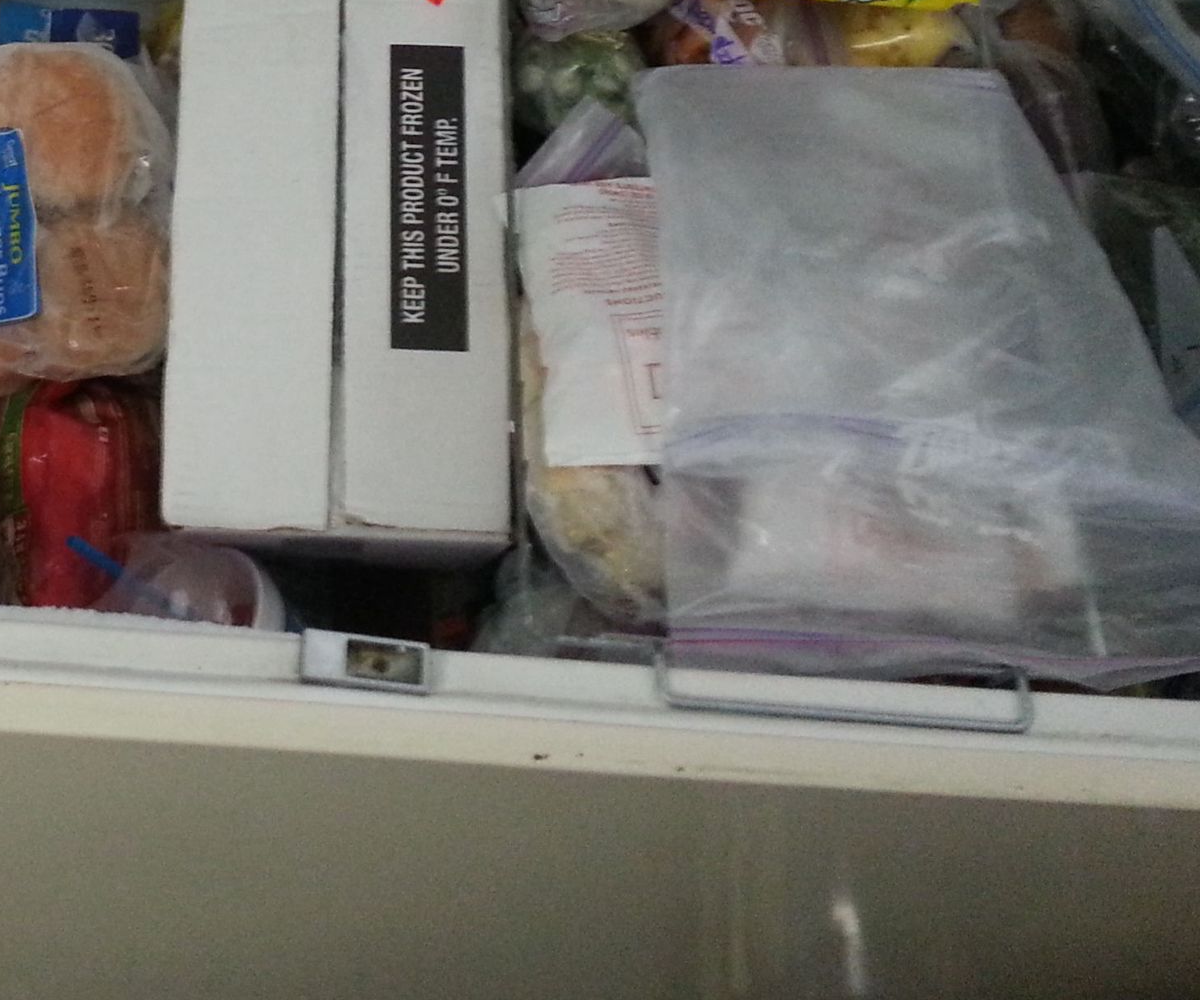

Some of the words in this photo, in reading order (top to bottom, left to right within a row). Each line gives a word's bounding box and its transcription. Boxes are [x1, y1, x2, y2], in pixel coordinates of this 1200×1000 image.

[400, 68, 425, 137] FROZEN
[435, 117, 459, 167] TEMP.
[401, 140, 426, 225] PRODUCT
[437, 172, 459, 185] F
[2, 184, 23, 265] JUMBO
[402, 229, 426, 271] THIS
[436, 212, 461, 274] UNDER
[402, 276, 426, 324] KEEP
